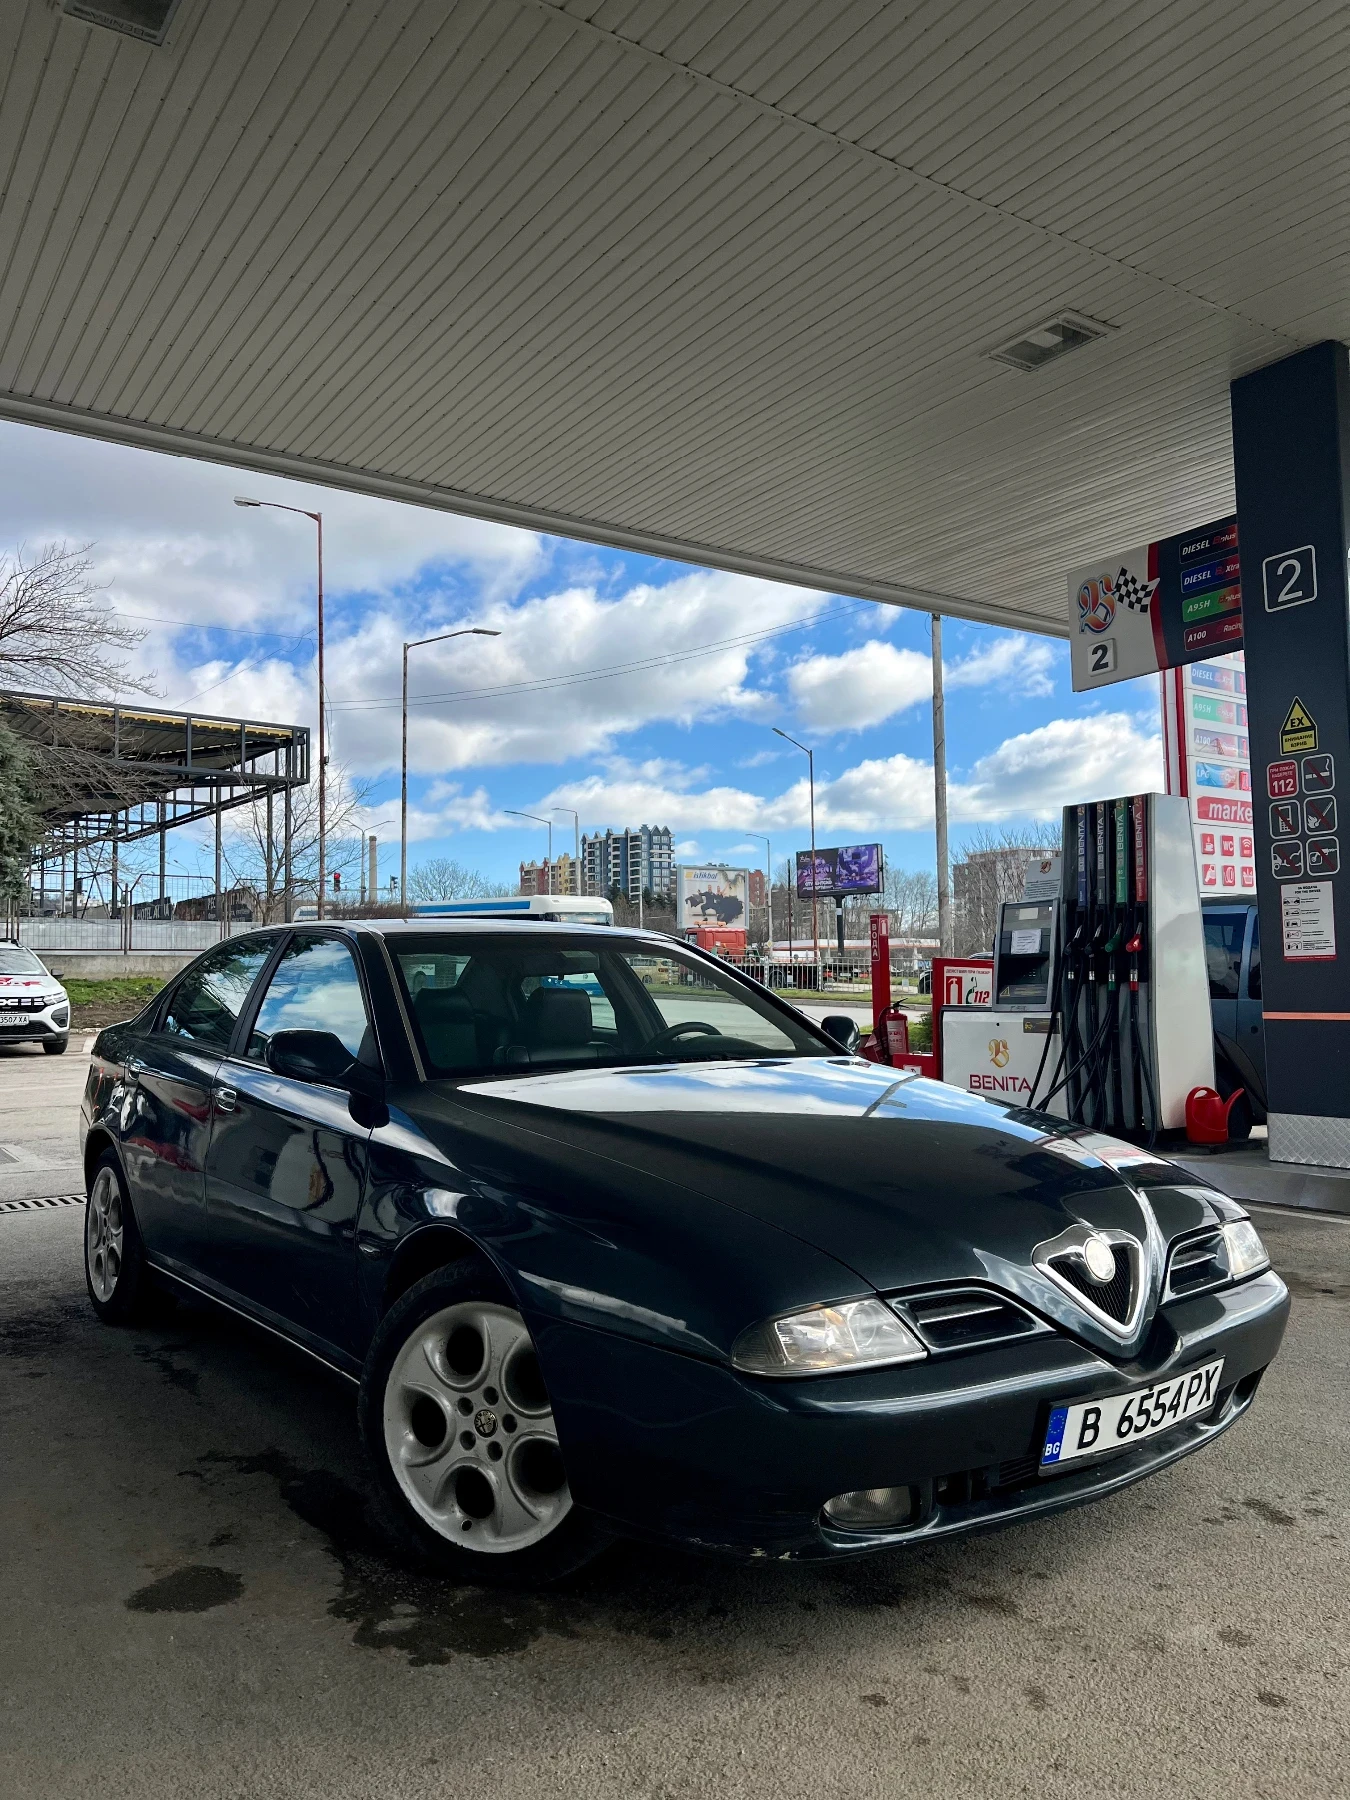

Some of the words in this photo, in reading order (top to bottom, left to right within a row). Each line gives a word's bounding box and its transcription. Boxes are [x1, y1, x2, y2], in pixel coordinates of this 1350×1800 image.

[1182, 539, 1210, 556] DIESEL
[1183, 570, 1212, 586] DIESEL
[1276, 558, 1303, 603] 2
[1187, 599, 1211, 614] A95H
[1187, 630, 1207, 643] A100
[1091, 643, 1109, 672] 2
[1191, 668, 1213, 681] DIESEL
[1193, 703, 1212, 714] A95H
[1290, 716, 1305, 728] EX
[1195, 734, 1211, 745] A100
[1196, 769, 1209, 779] LPG
[1272, 778, 1295, 794] 112
[1223, 840, 1234, 851] WC
[974, 990, 990, 1004] 112
[969, 1074, 1033, 1093] BENITA
[1077, 1406, 1102, 1450] B
[1044, 1443, 1060, 1456] BG
